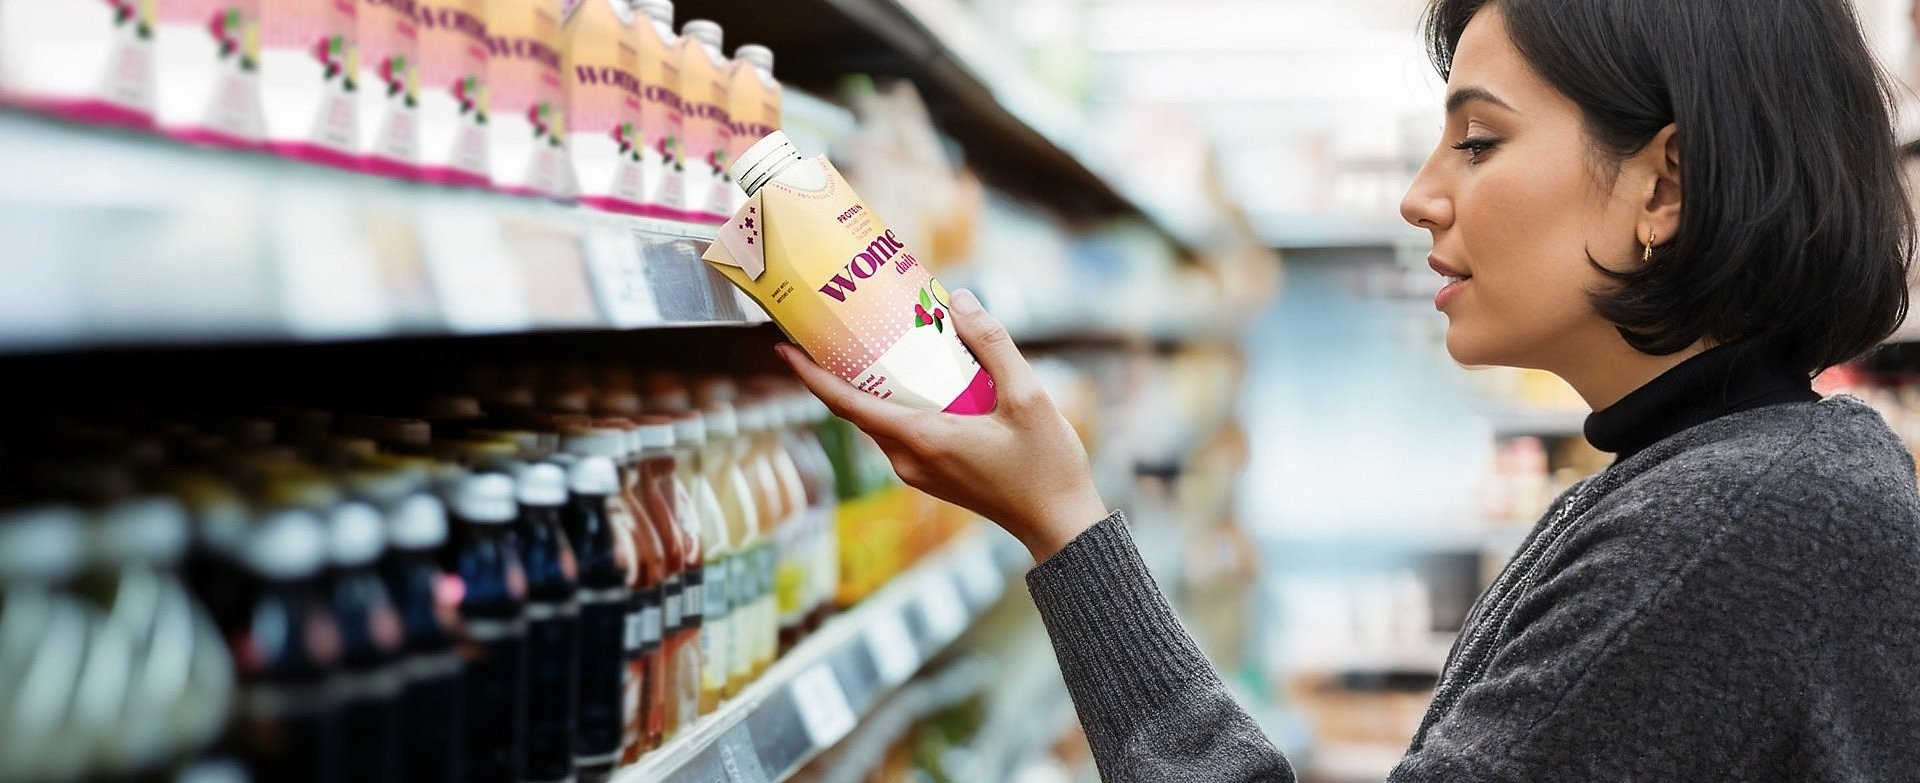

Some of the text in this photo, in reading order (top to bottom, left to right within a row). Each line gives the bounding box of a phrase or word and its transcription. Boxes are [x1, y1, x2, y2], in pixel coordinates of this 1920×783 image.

[836, 204, 863, 224] PROTEIN
[819, 228, 904, 303] wome
[895, 253, 919, 275] daily
[868, 376, 887, 391] strength
